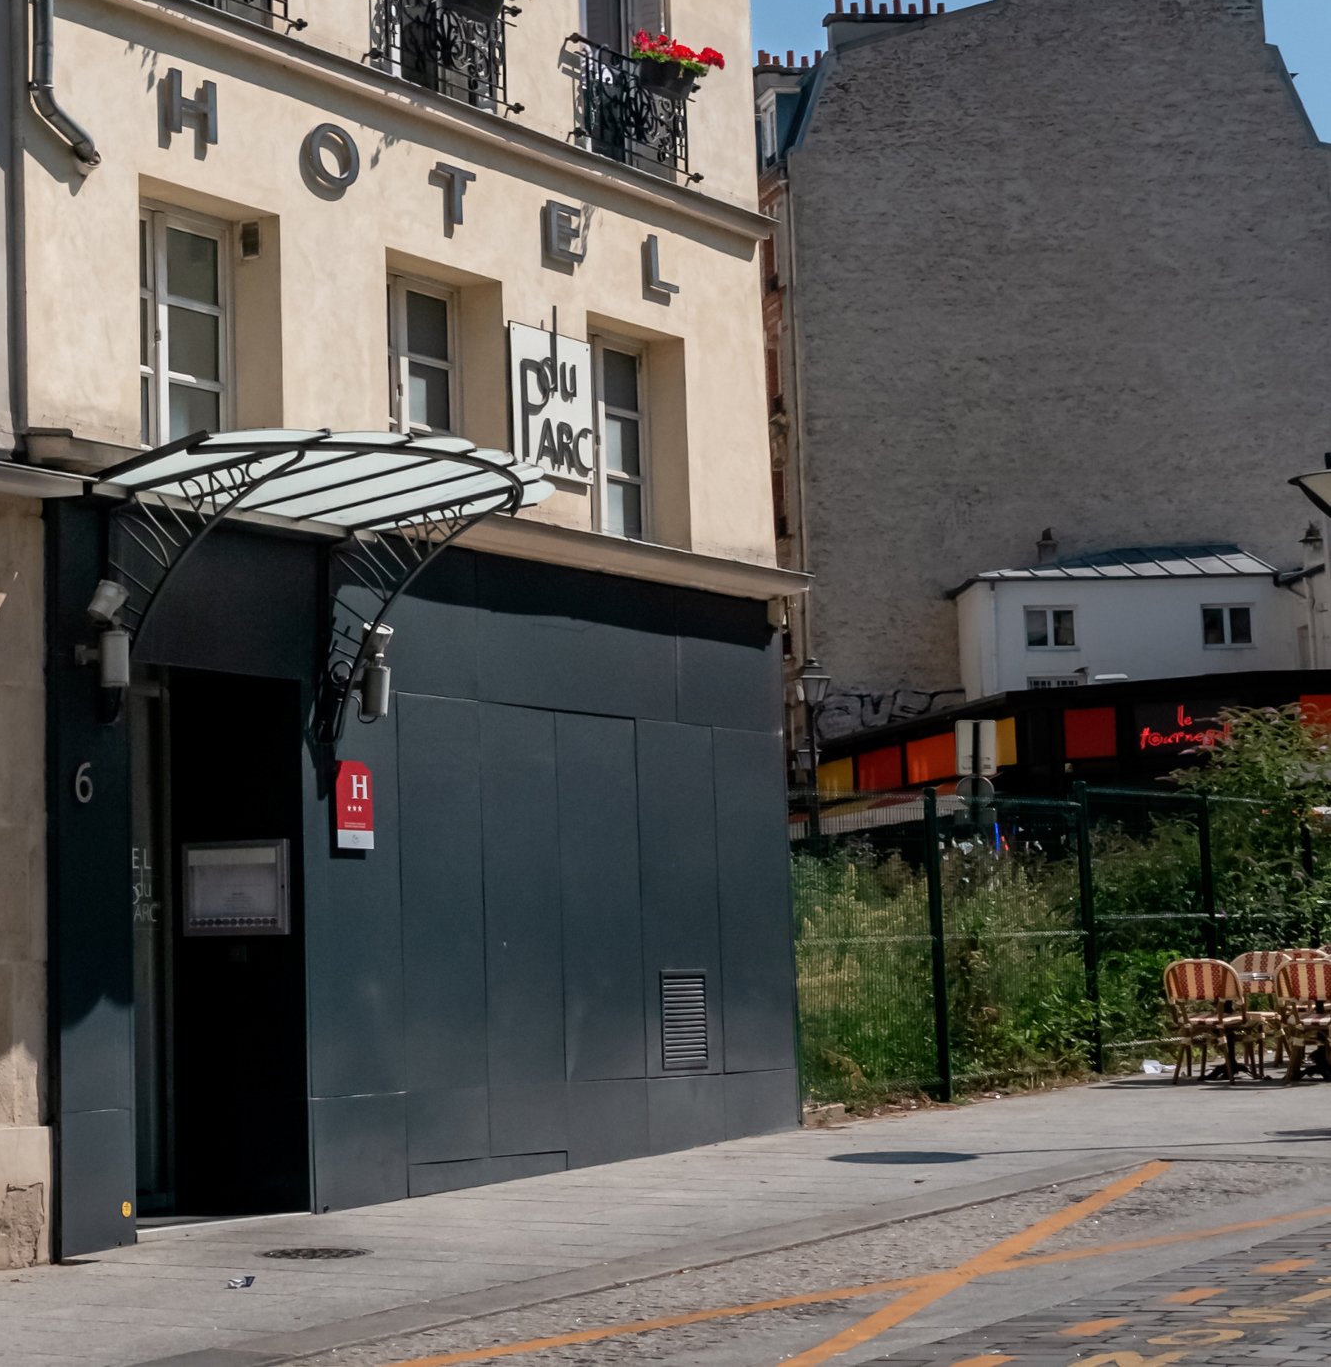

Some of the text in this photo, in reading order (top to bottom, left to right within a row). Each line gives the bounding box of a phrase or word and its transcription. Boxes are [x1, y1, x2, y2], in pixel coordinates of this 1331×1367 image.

[167, 67, 680, 295] HOTEL
[540, 305, 577, 399] du
[520, 358, 593, 473] PARC
[1176, 704, 1194, 727] le
[74, 761, 94, 804] 6
[350, 774, 370, 800] H
